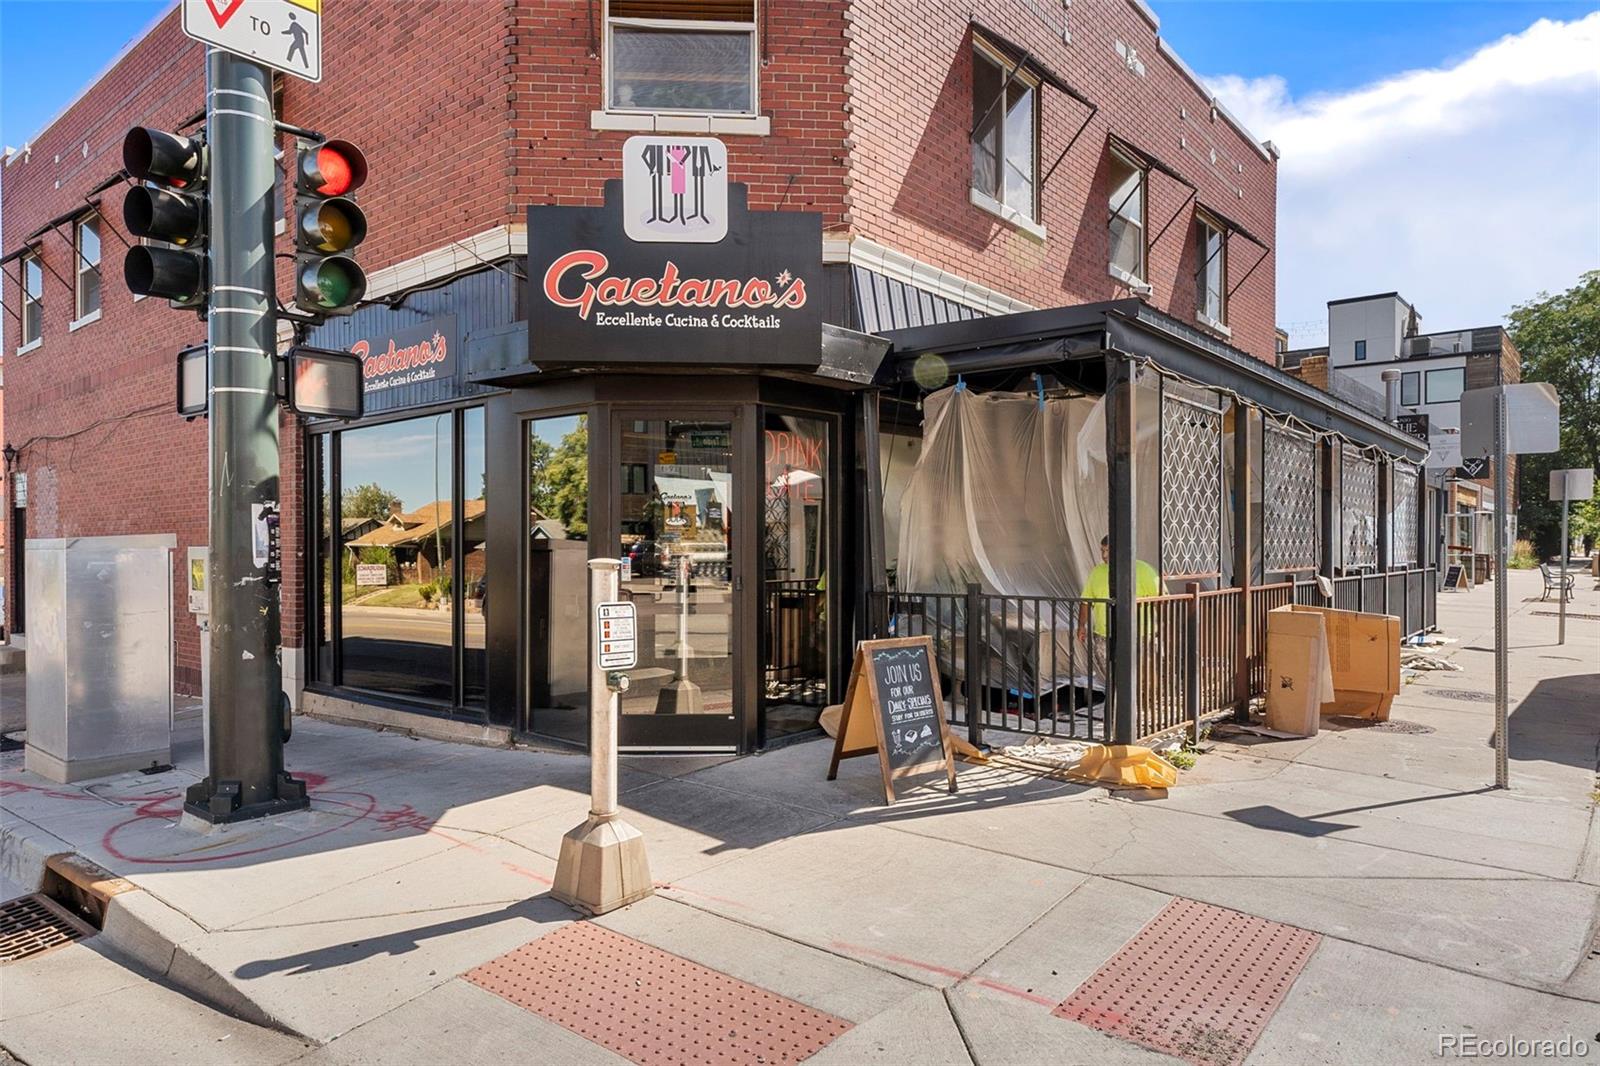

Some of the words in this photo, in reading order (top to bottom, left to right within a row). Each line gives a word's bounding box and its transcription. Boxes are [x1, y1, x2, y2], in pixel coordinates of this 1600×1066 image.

[250, 16, 271, 36] TO
[544, 250, 807, 320] Gaetano's
[596, 312, 662, 327] Eccellente
[665, 313, 708, 328] Cucina
[711, 314, 720, 328] &
[765, 430, 822, 471] DRINK
[885, 664, 908, 685] JOIN
[909, 663, 922, 682] US
[890, 686, 902, 698] FOR
[902, 685, 914, 697] OUR
